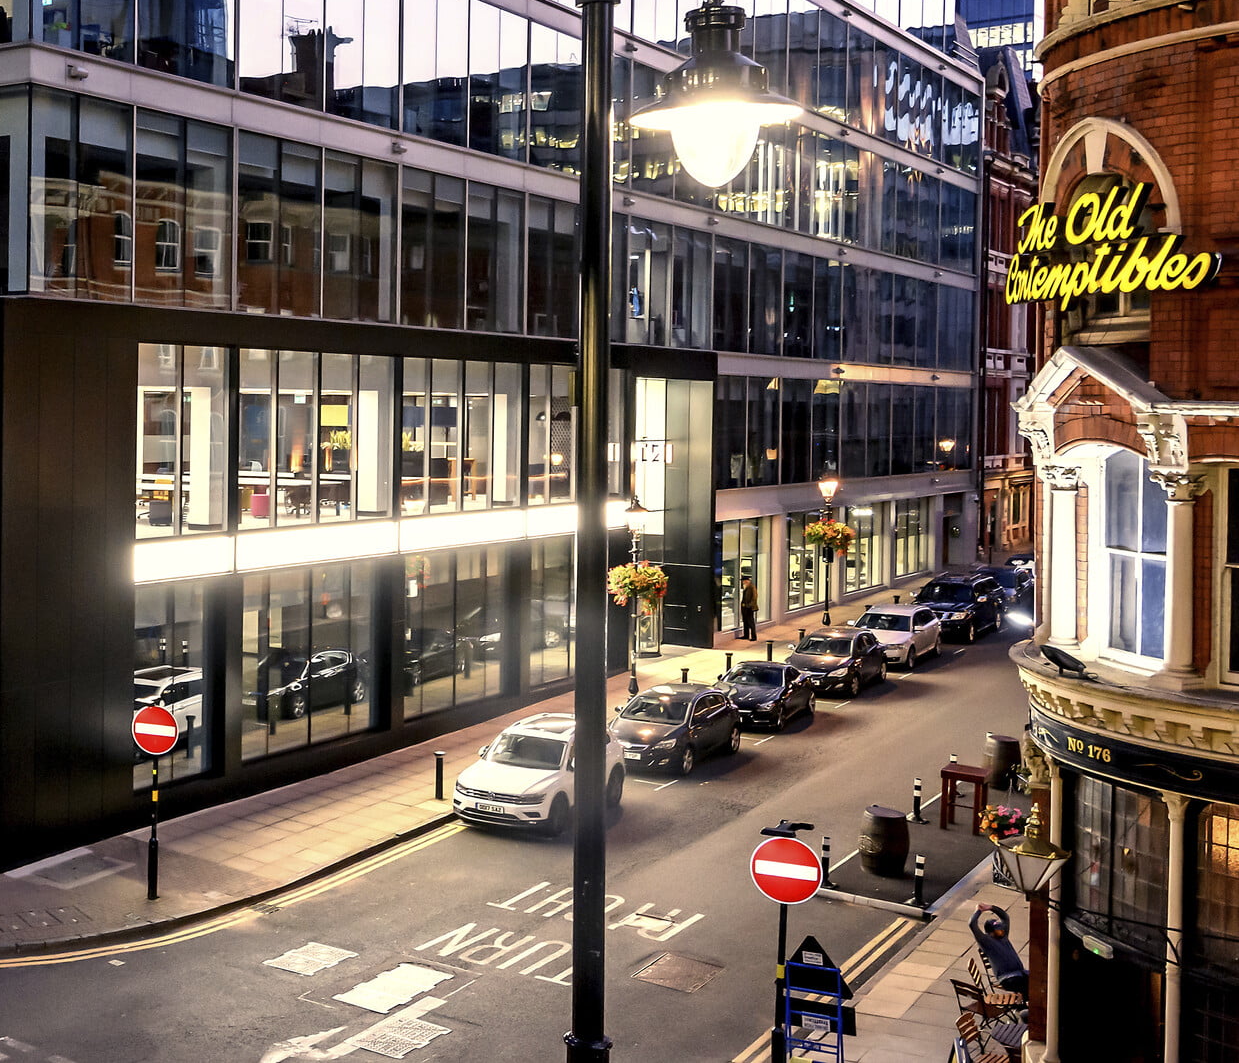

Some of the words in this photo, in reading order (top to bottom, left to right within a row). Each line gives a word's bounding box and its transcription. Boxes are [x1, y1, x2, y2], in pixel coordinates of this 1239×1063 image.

[1018, 202, 1058, 254] The
[1065, 182, 1144, 245] Old
[1005, 235, 1211, 311] Contemptibles
[1088, 744, 1111, 763] 176
